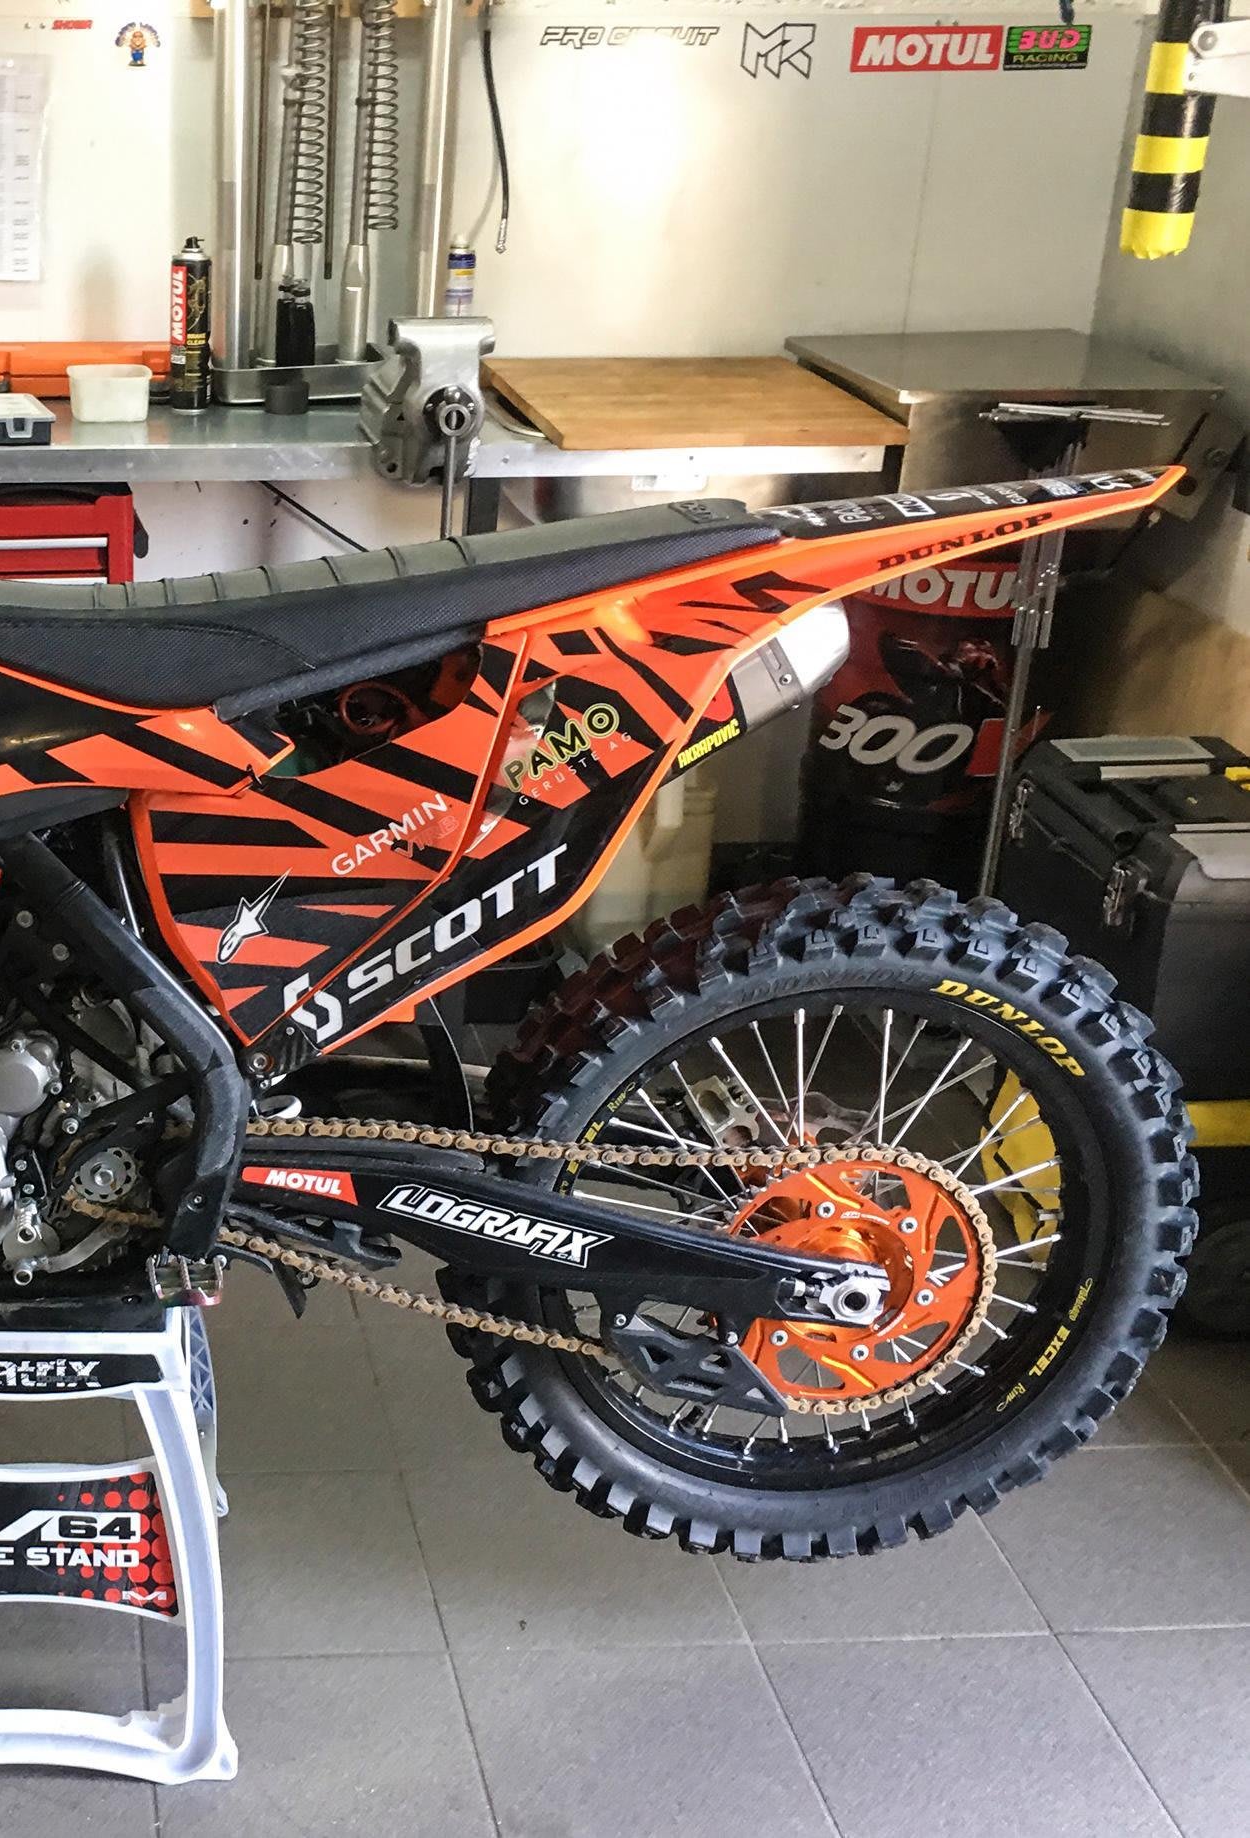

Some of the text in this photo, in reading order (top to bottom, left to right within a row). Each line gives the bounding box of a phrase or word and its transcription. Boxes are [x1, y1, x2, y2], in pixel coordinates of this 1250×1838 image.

[540, 26, 606, 50] PRO
[857, 33, 995, 66] MOTUL
[1011, 53, 1079, 63] RACING
[1018, 28, 1082, 51] BUD
[171, 270, 184, 343] MOTUL
[877, 511, 1053, 571] DUNLOP
[866, 566, 1028, 611] MOTU
[502, 702, 620, 793] PAMO
[818, 704, 974, 774] 300
[330, 792, 449, 876] GARMIN
[347, 842, 568, 1005] SCOTT
[930, 979, 1087, 1077] DUNLOP
[264, 1169, 343, 1196] MOTUL
[386, 1188, 600, 1260] LOGRAFIX
[1028, 1325, 1071, 1377] EXCEL
[26, 1548, 141, 1568] STAND
